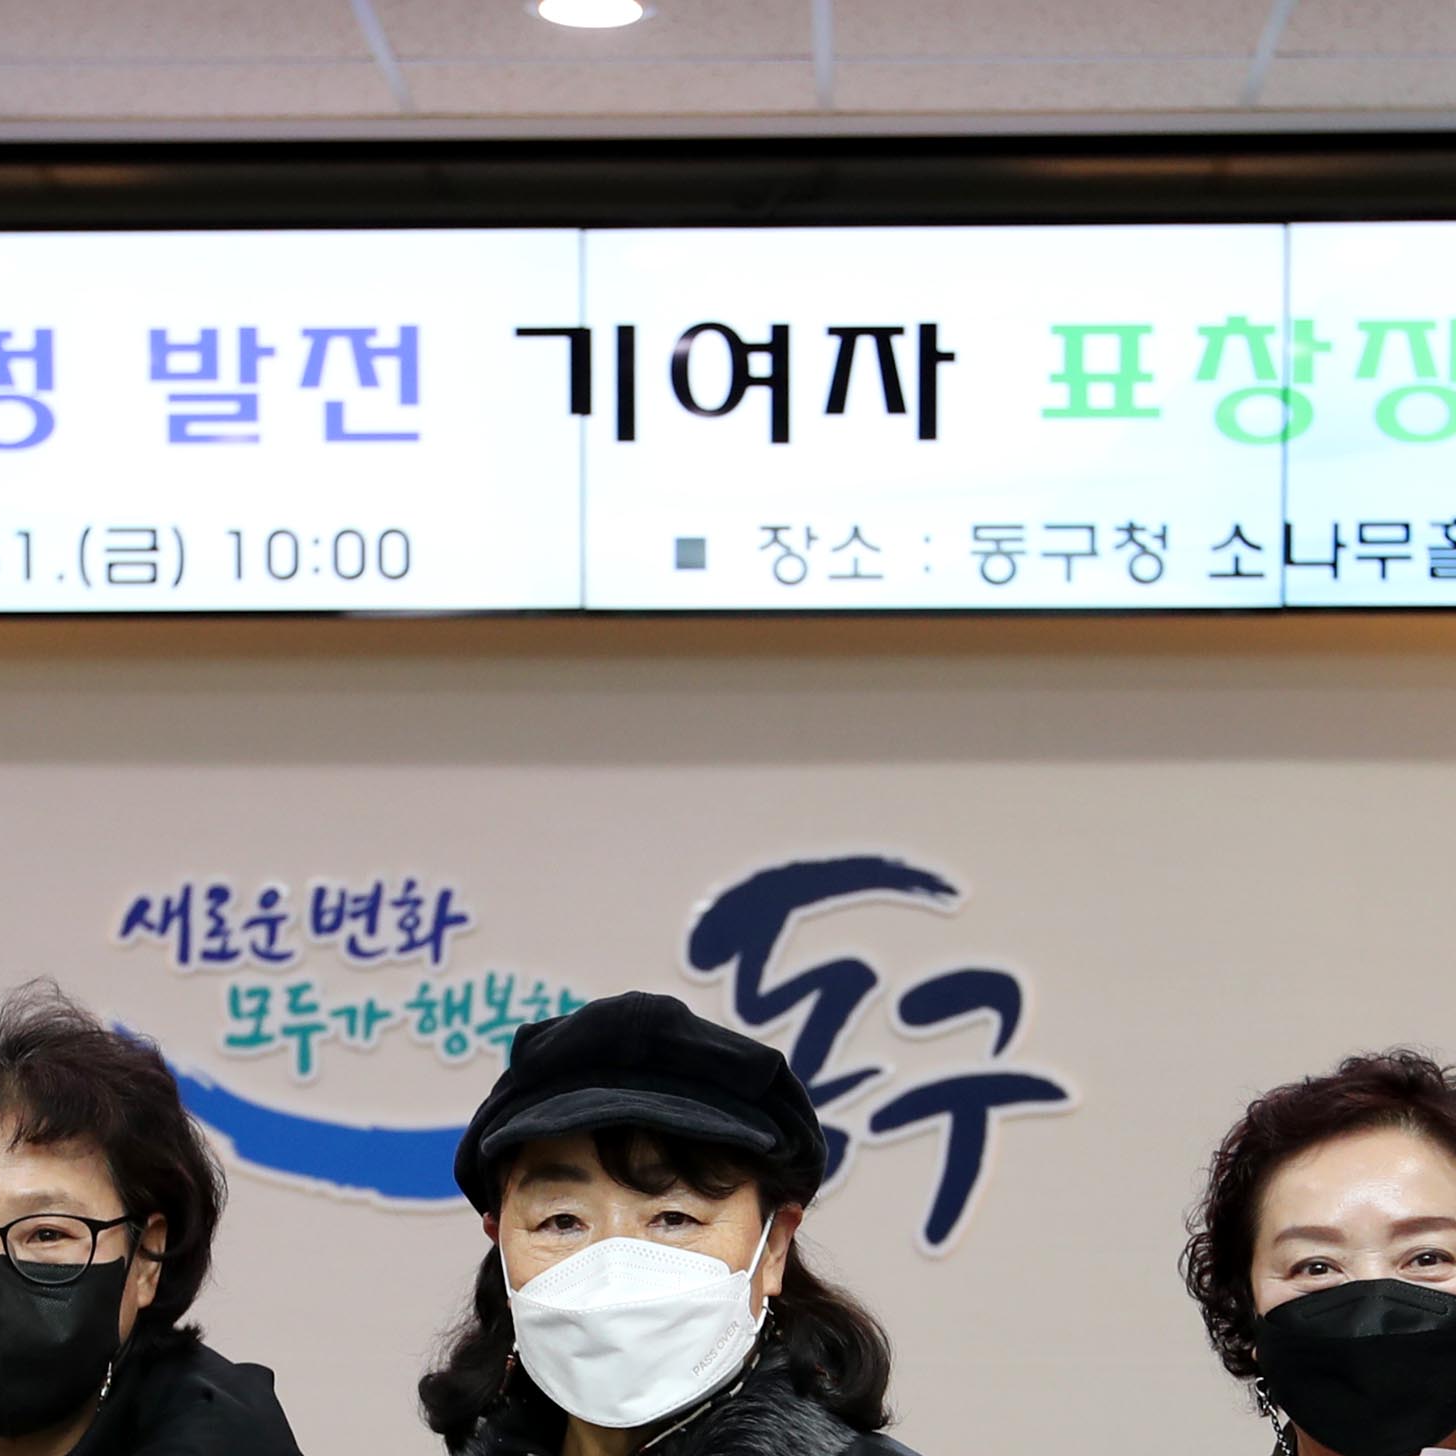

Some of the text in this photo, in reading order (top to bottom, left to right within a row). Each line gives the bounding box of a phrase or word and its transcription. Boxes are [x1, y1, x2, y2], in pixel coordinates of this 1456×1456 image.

[149, 325, 420, 444] 발전
[513, 320, 957, 445] 기여자
[228, 528, 411, 581] 10:00
[761, 525, 882, 586] 장소
[972, 520, 1169, 586] 동구청
[118, 878, 470, 968] 새로운 변화
[225, 982, 392, 1074] 모두가
[686, 856, 1070, 1246] 동구
